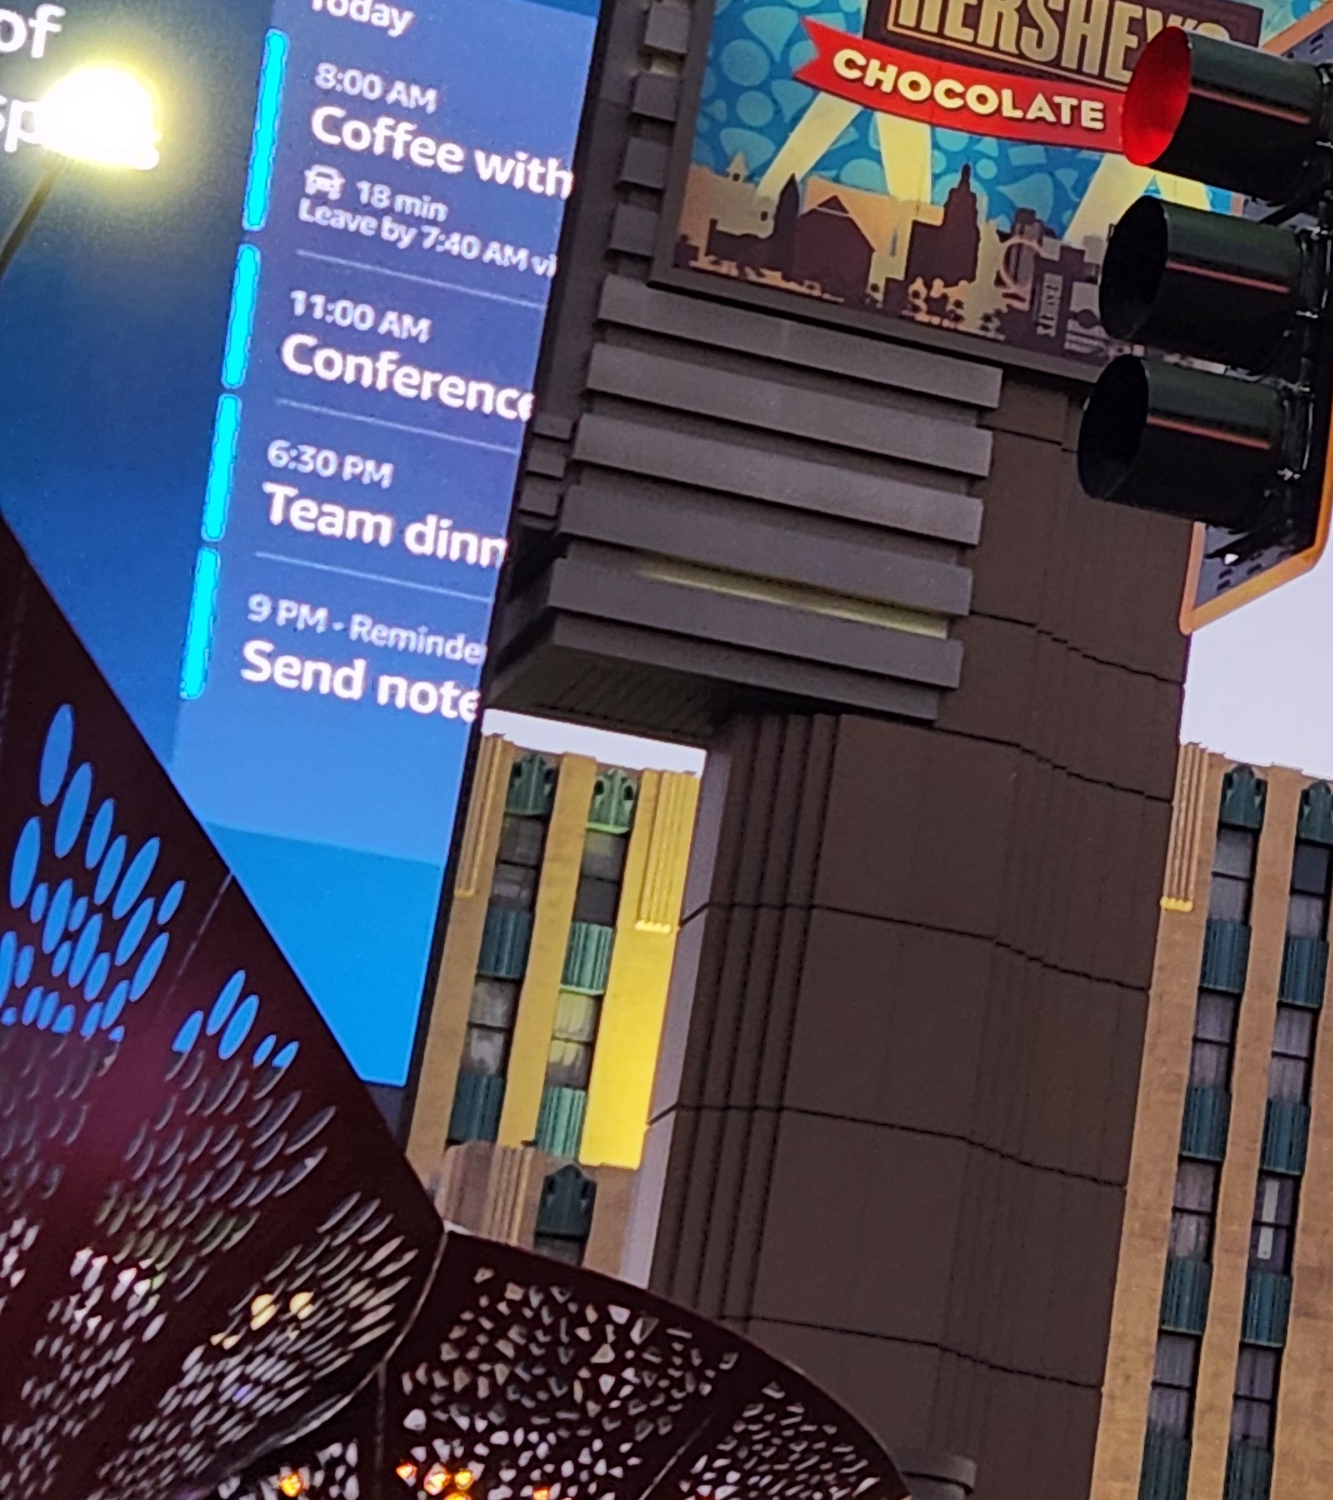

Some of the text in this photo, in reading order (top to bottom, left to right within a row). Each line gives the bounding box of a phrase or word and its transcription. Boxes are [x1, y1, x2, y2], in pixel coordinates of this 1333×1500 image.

[314, 62, 439, 115] 8:00 AM
[832, 47, 1106, 132] CHOCOLATE
[311, 105, 574, 201] Coffee with
[356, 180, 449, 223] 18 min
[298, 197, 379, 237] Leave
[380, 215, 417, 249] by
[420, 225, 482, 260] 7:40
[481, 240, 529, 272] AM
[290, 290, 433, 343] 11:00 AM
[267, 439, 394, 489] 6:30 PM
[262, 481, 508, 569] Team dinn
[247, 593, 273, 623] 9
[276, 599, 329, 634] PM
[241, 639, 367, 701] Send
